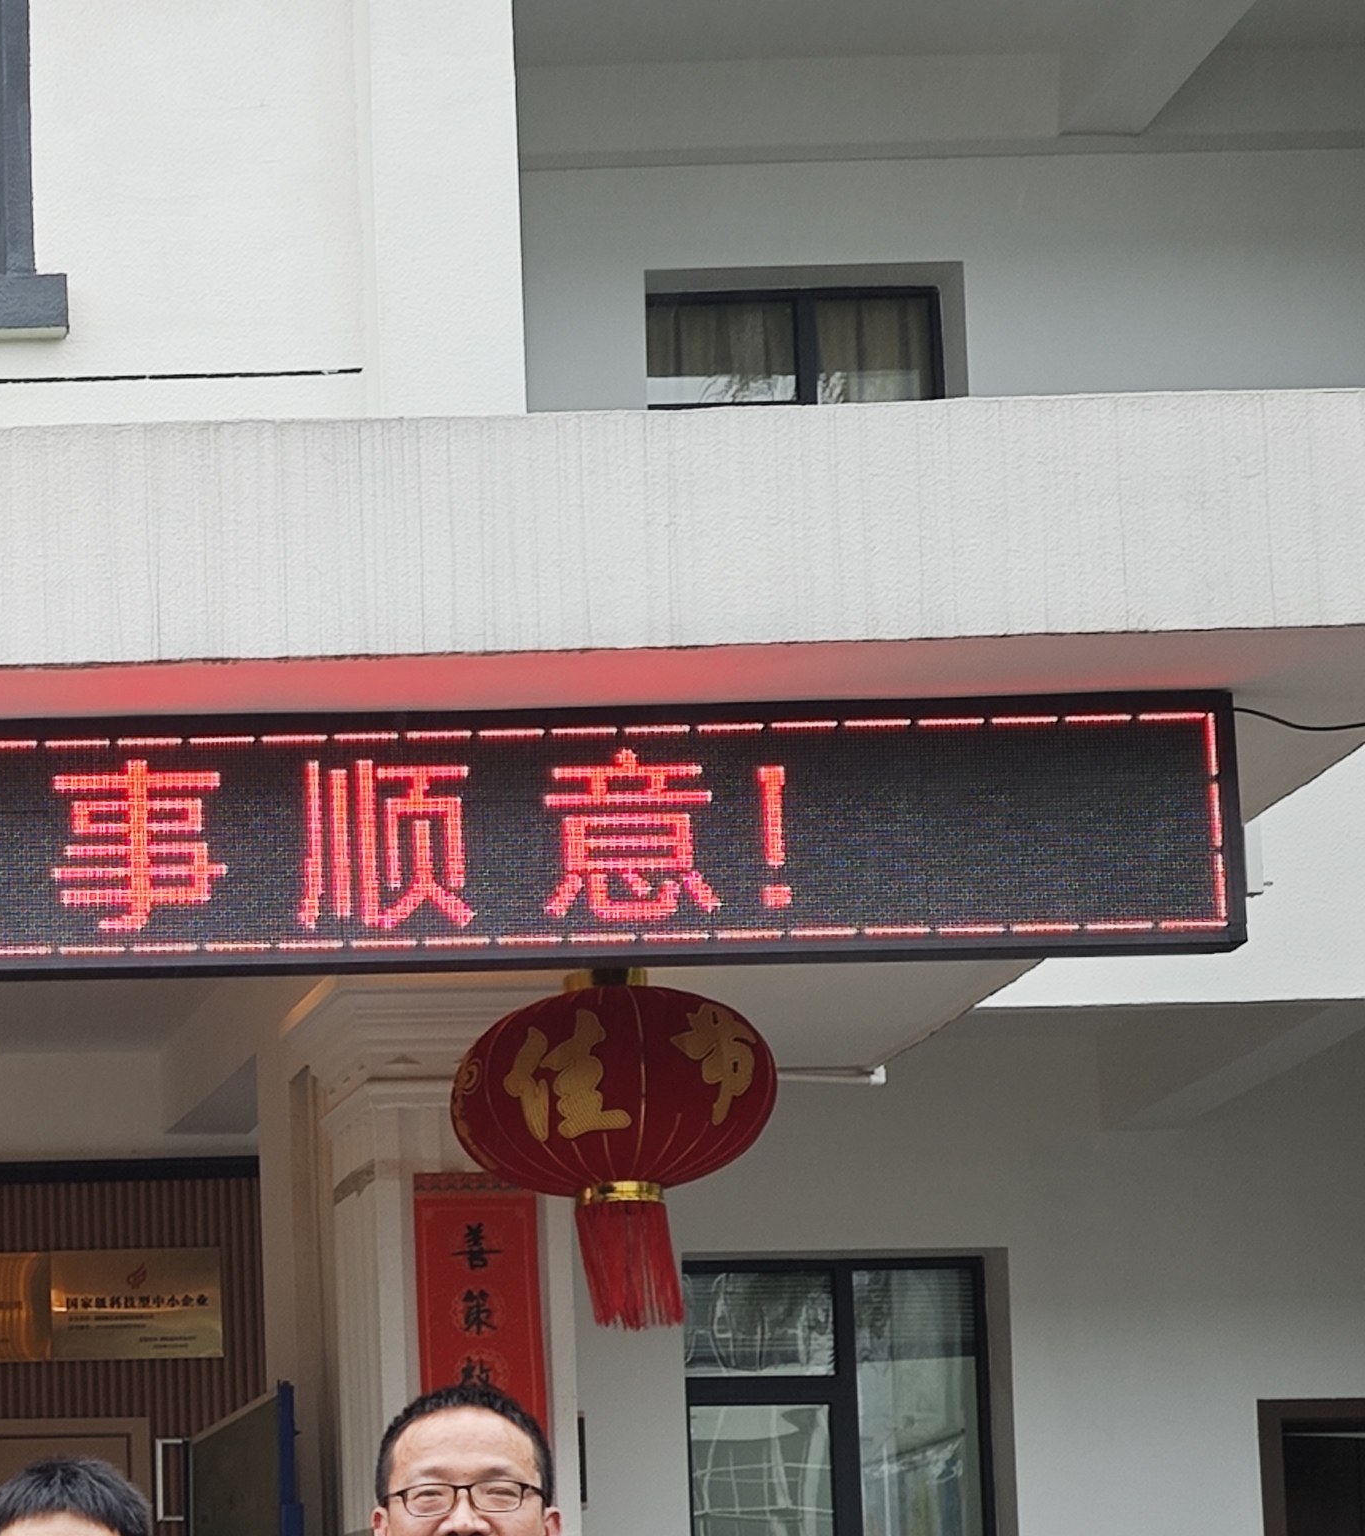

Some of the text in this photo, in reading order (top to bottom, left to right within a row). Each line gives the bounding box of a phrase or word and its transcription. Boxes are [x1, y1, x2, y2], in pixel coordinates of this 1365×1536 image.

[65, 1293, 209, 1310] 国家级科技型中小企业
